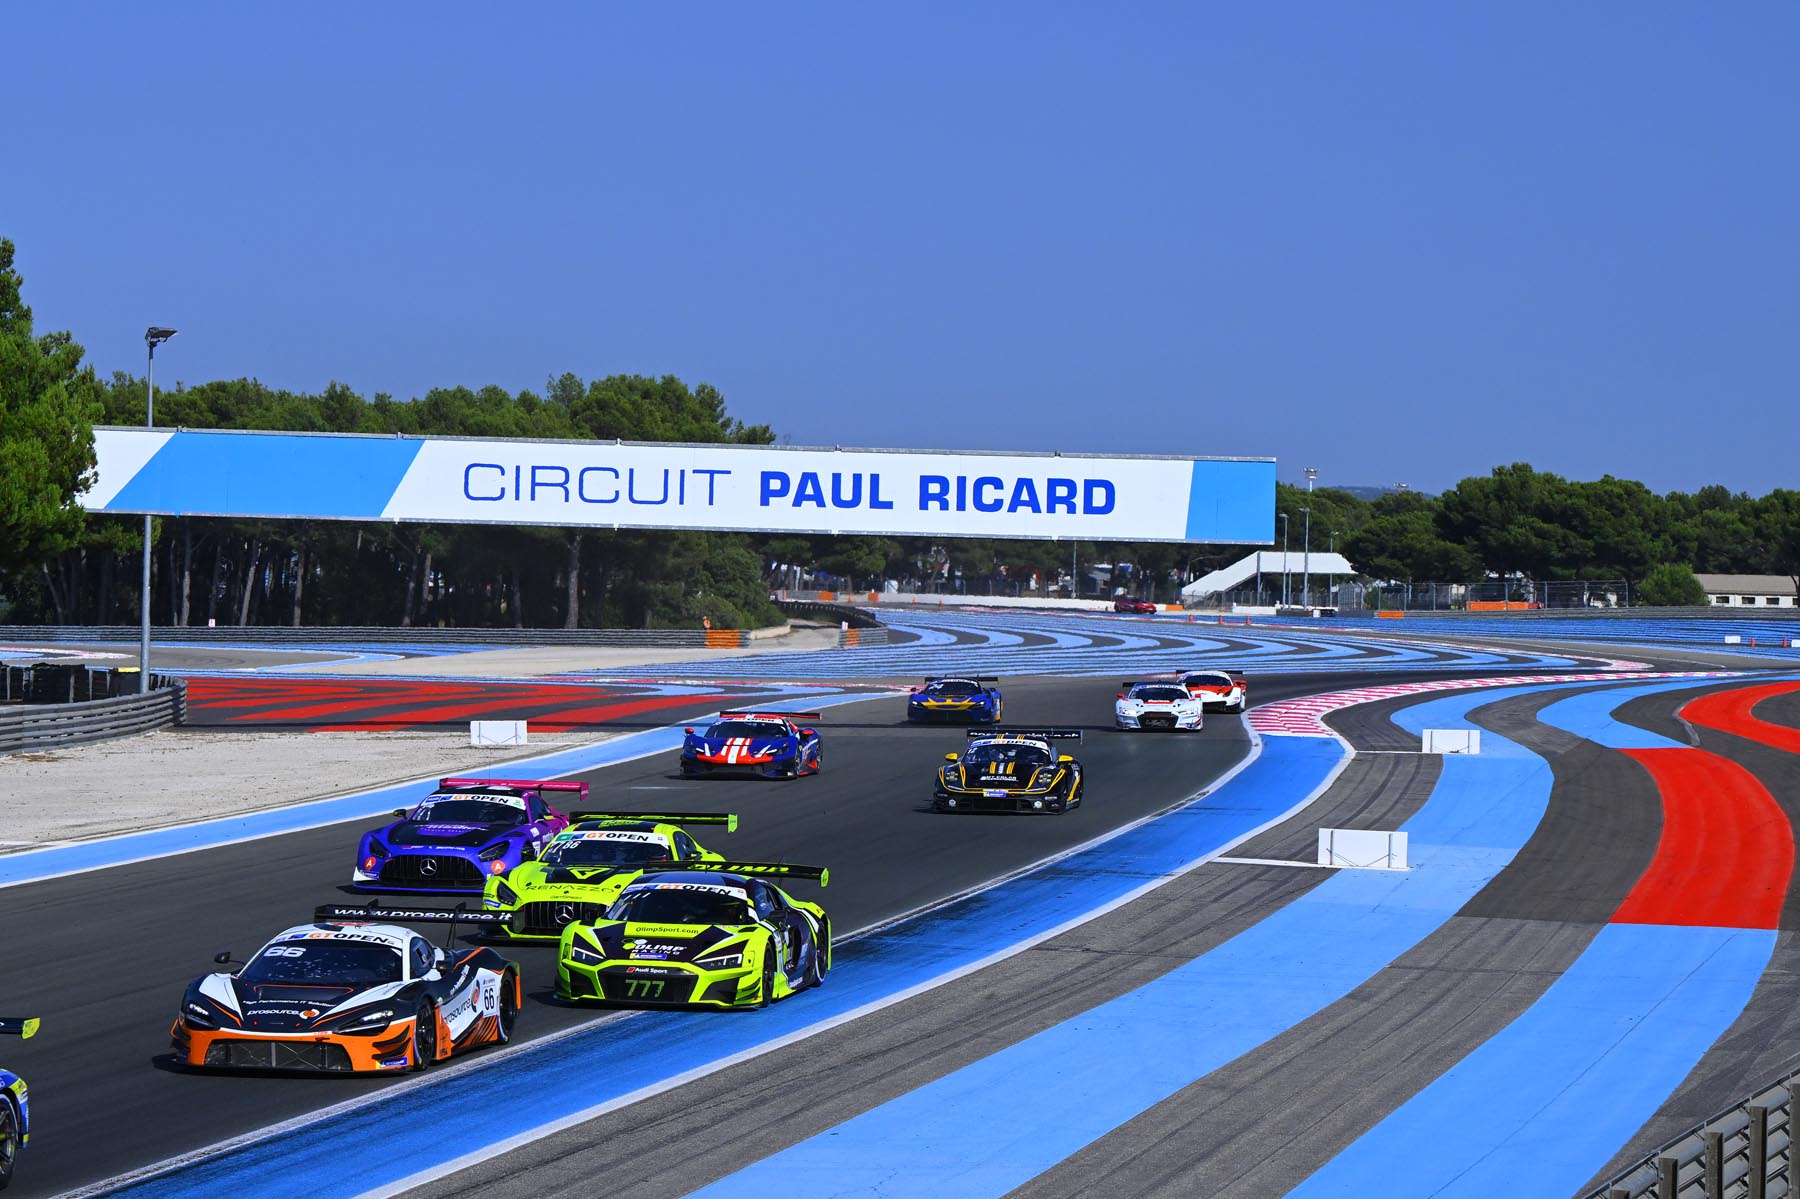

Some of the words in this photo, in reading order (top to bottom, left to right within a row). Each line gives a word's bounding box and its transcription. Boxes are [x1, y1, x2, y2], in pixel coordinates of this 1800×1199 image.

[463, 463, 731, 507] CIRCUIT
[759, 471, 894, 509] PAUL
[918, 475, 1116, 515] RICARD
[263, 946, 306, 958] 66
[484, 987, 495, 1011] 66
[625, 979, 665, 998] 777
